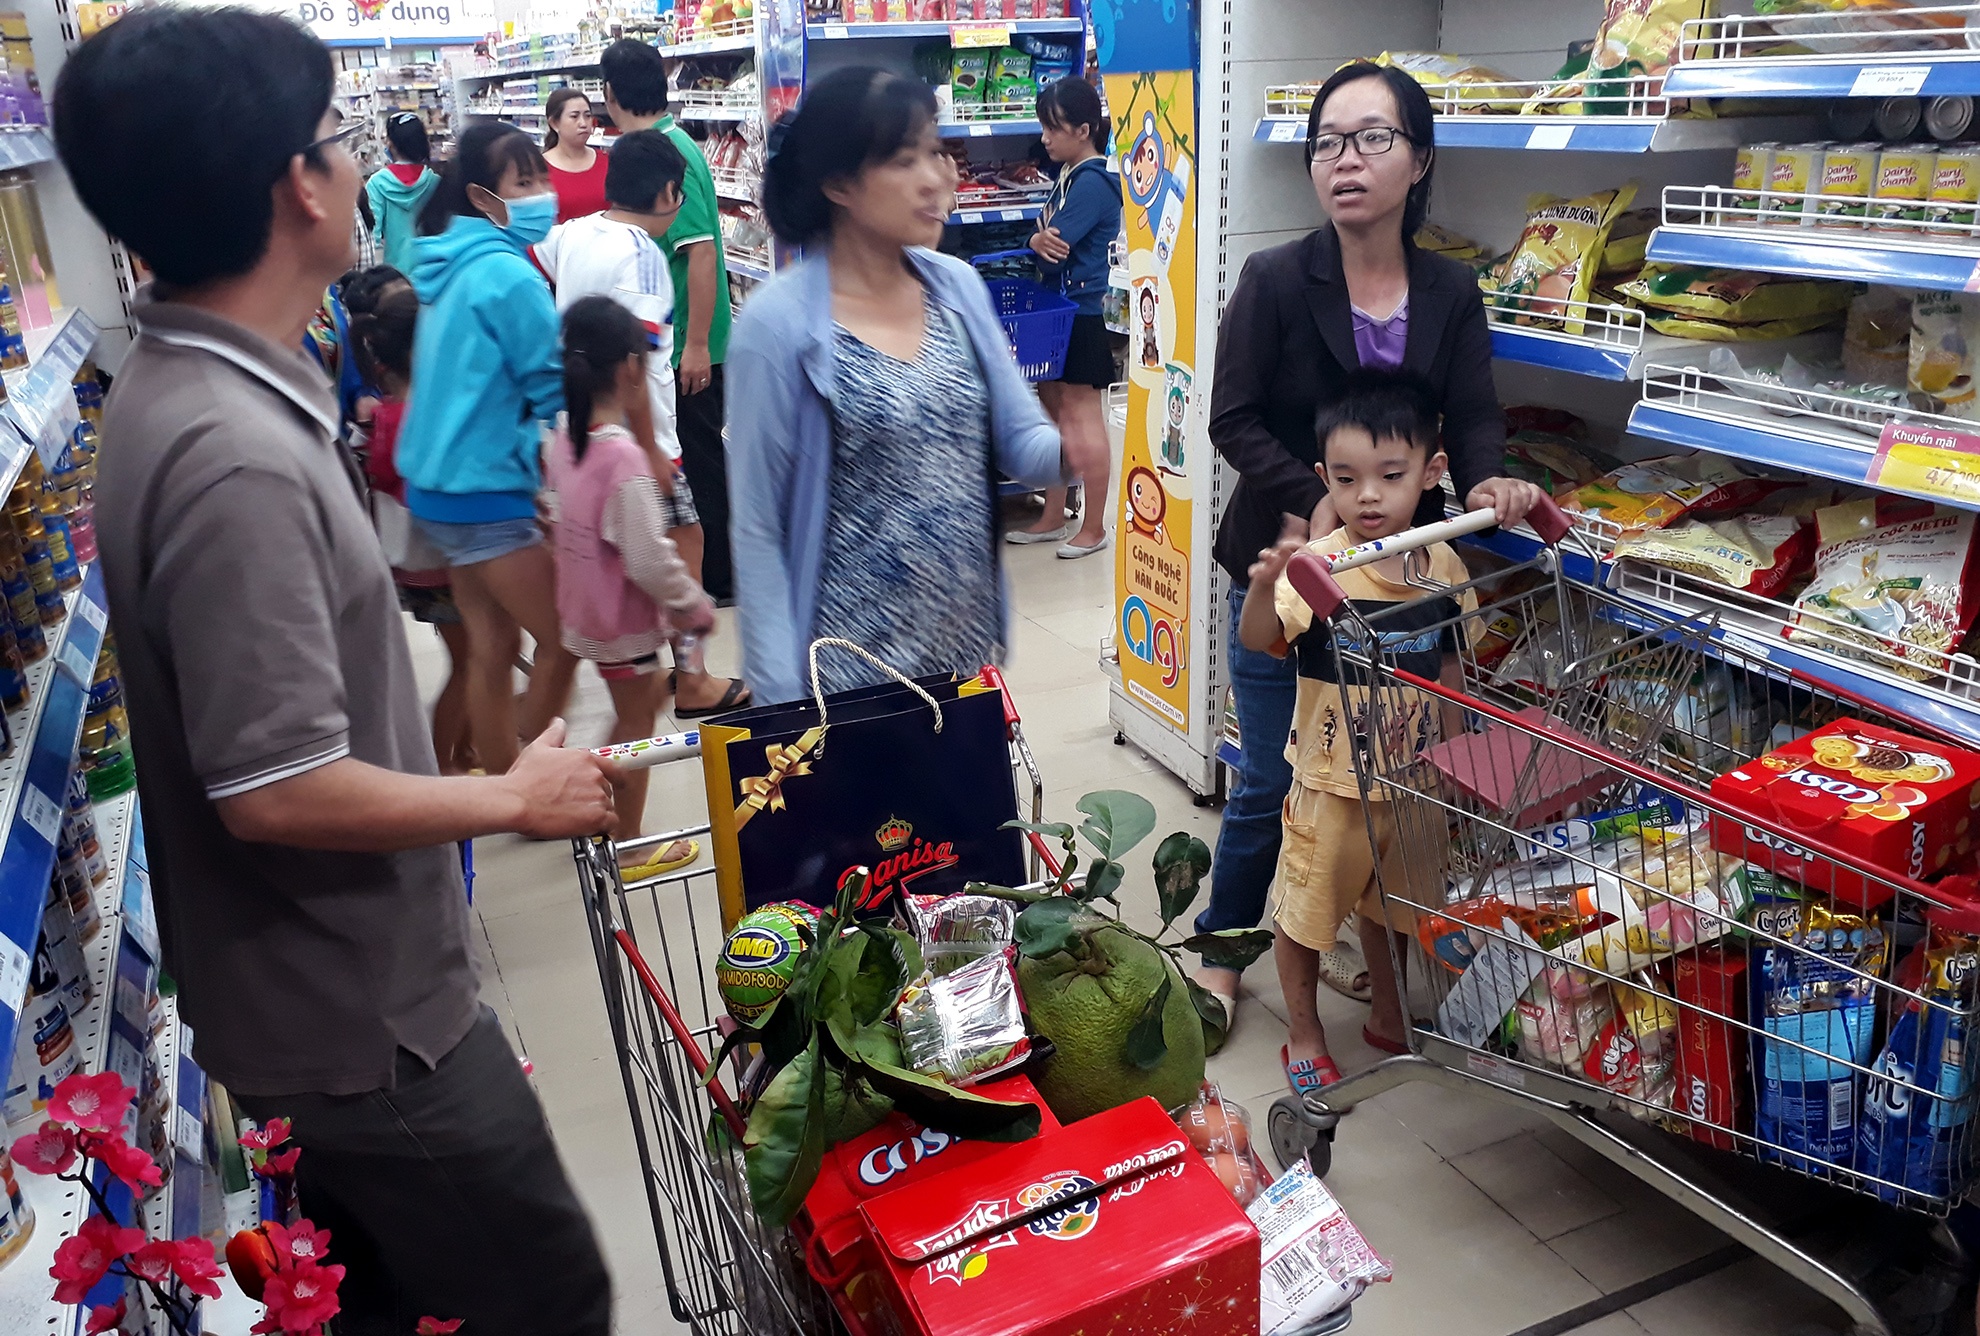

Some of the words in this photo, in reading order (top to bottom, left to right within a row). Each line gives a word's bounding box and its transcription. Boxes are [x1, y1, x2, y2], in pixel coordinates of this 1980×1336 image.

[391, 1, 450, 26] dụng
[1824, 173, 1858, 186] Champ
[1827, 164, 1854, 175] Dairy
[1883, 166, 1913, 177] Dairy
[1880, 175, 1917, 188] Champ
[1892, 429, 1933, 445] Khuyến
[1157, 556, 1182, 586] Nghệ
[1135, 566, 1152, 591] HÀN
[1154, 580, 1179, 606] QUỐC
[1778, 769, 1882, 804] COSY
[859, 1127, 962, 1186] COS
